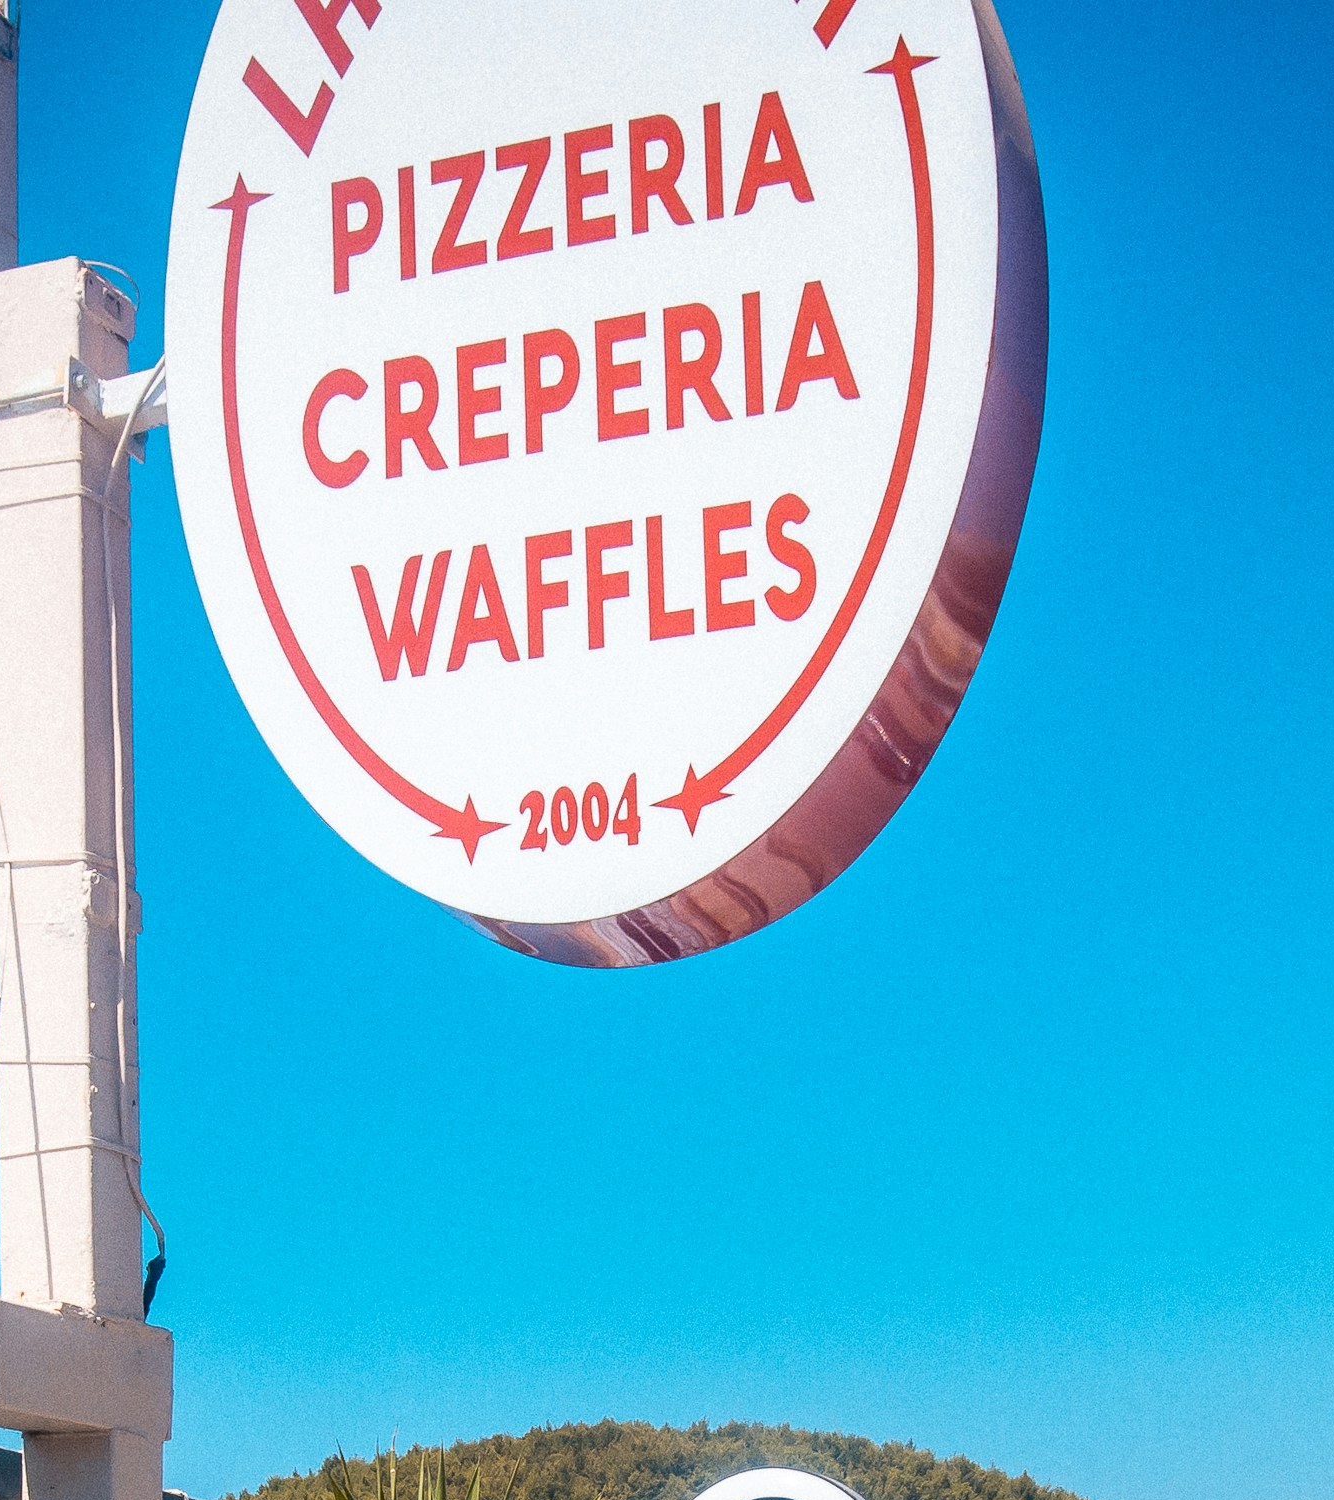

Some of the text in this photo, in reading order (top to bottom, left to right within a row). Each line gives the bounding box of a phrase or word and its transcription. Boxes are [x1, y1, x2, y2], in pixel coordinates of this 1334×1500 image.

[331, 91, 815, 294] PIZZERIA
[302, 280, 861, 489] CREPERIA
[351, 492, 818, 682] WAFFLES
[519, 772, 641, 852] 2004
